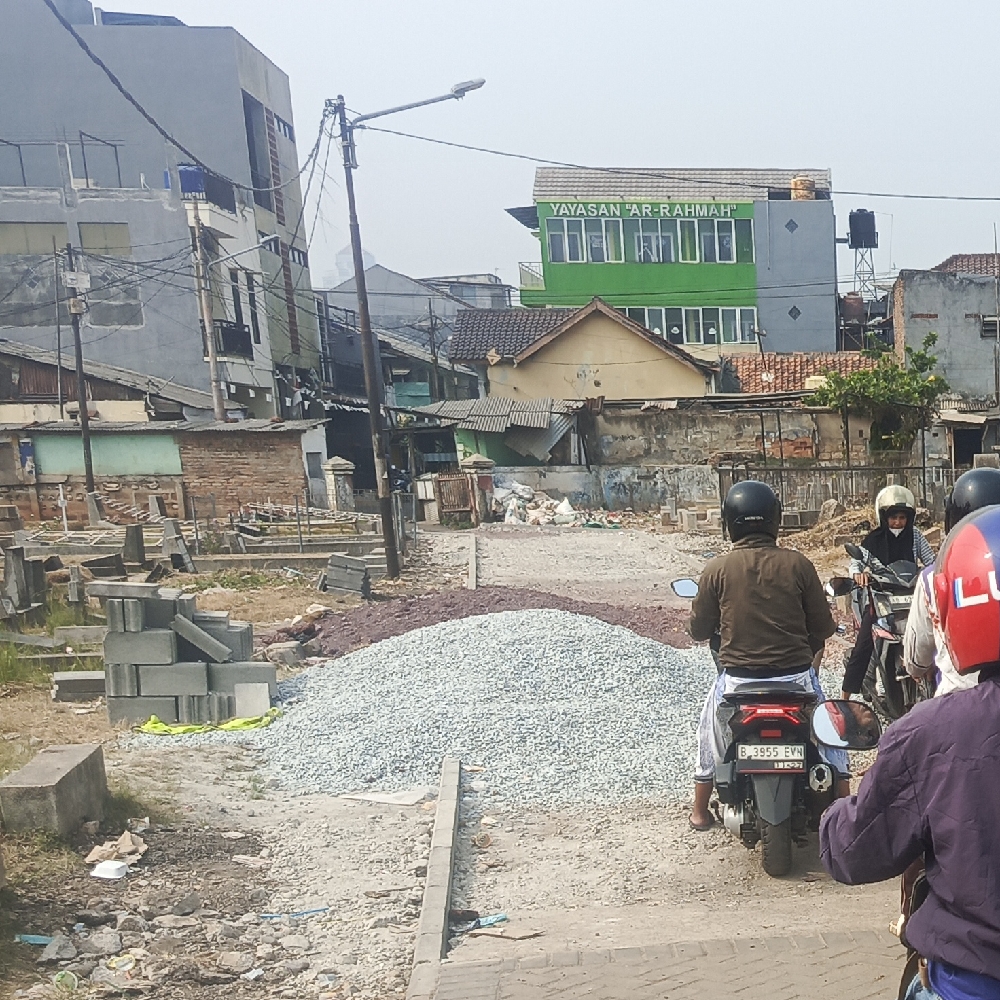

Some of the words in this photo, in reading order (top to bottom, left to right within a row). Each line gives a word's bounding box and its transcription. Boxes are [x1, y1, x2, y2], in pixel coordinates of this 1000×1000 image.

[550, 203, 620, 217] YAYASAN
[741, 747, 747, 757] B
[753, 747, 779, 757] 3955
